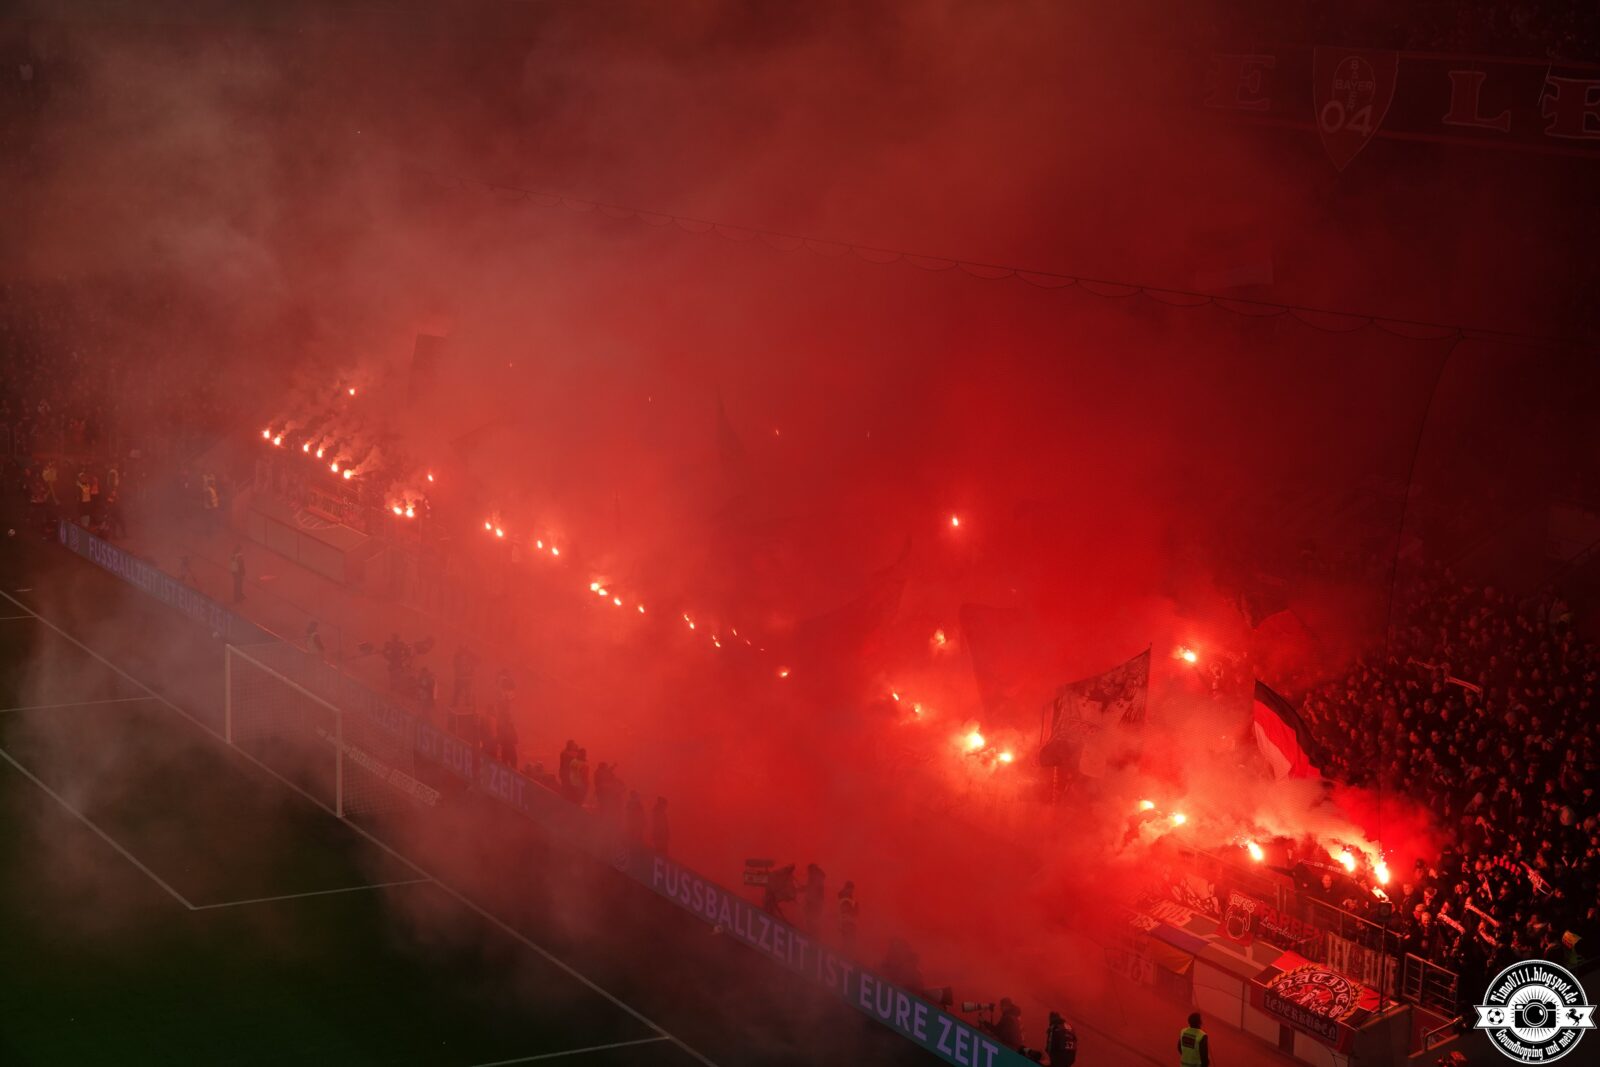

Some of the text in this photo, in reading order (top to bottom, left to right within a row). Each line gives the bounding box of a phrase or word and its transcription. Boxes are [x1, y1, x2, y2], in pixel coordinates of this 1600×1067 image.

[1335, 79, 1374, 91] BAYER
[1320, 100, 1374, 137] 04
[88, 535, 159, 594] FUSSBALLZEIT
[417, 722, 441, 757] IST
[443, 736, 485, 784] EUR
[652, 856, 810, 969] FUSSBALLZEIT
[817, 947, 854, 997] IST
[859, 974, 928, 1041] EURE
